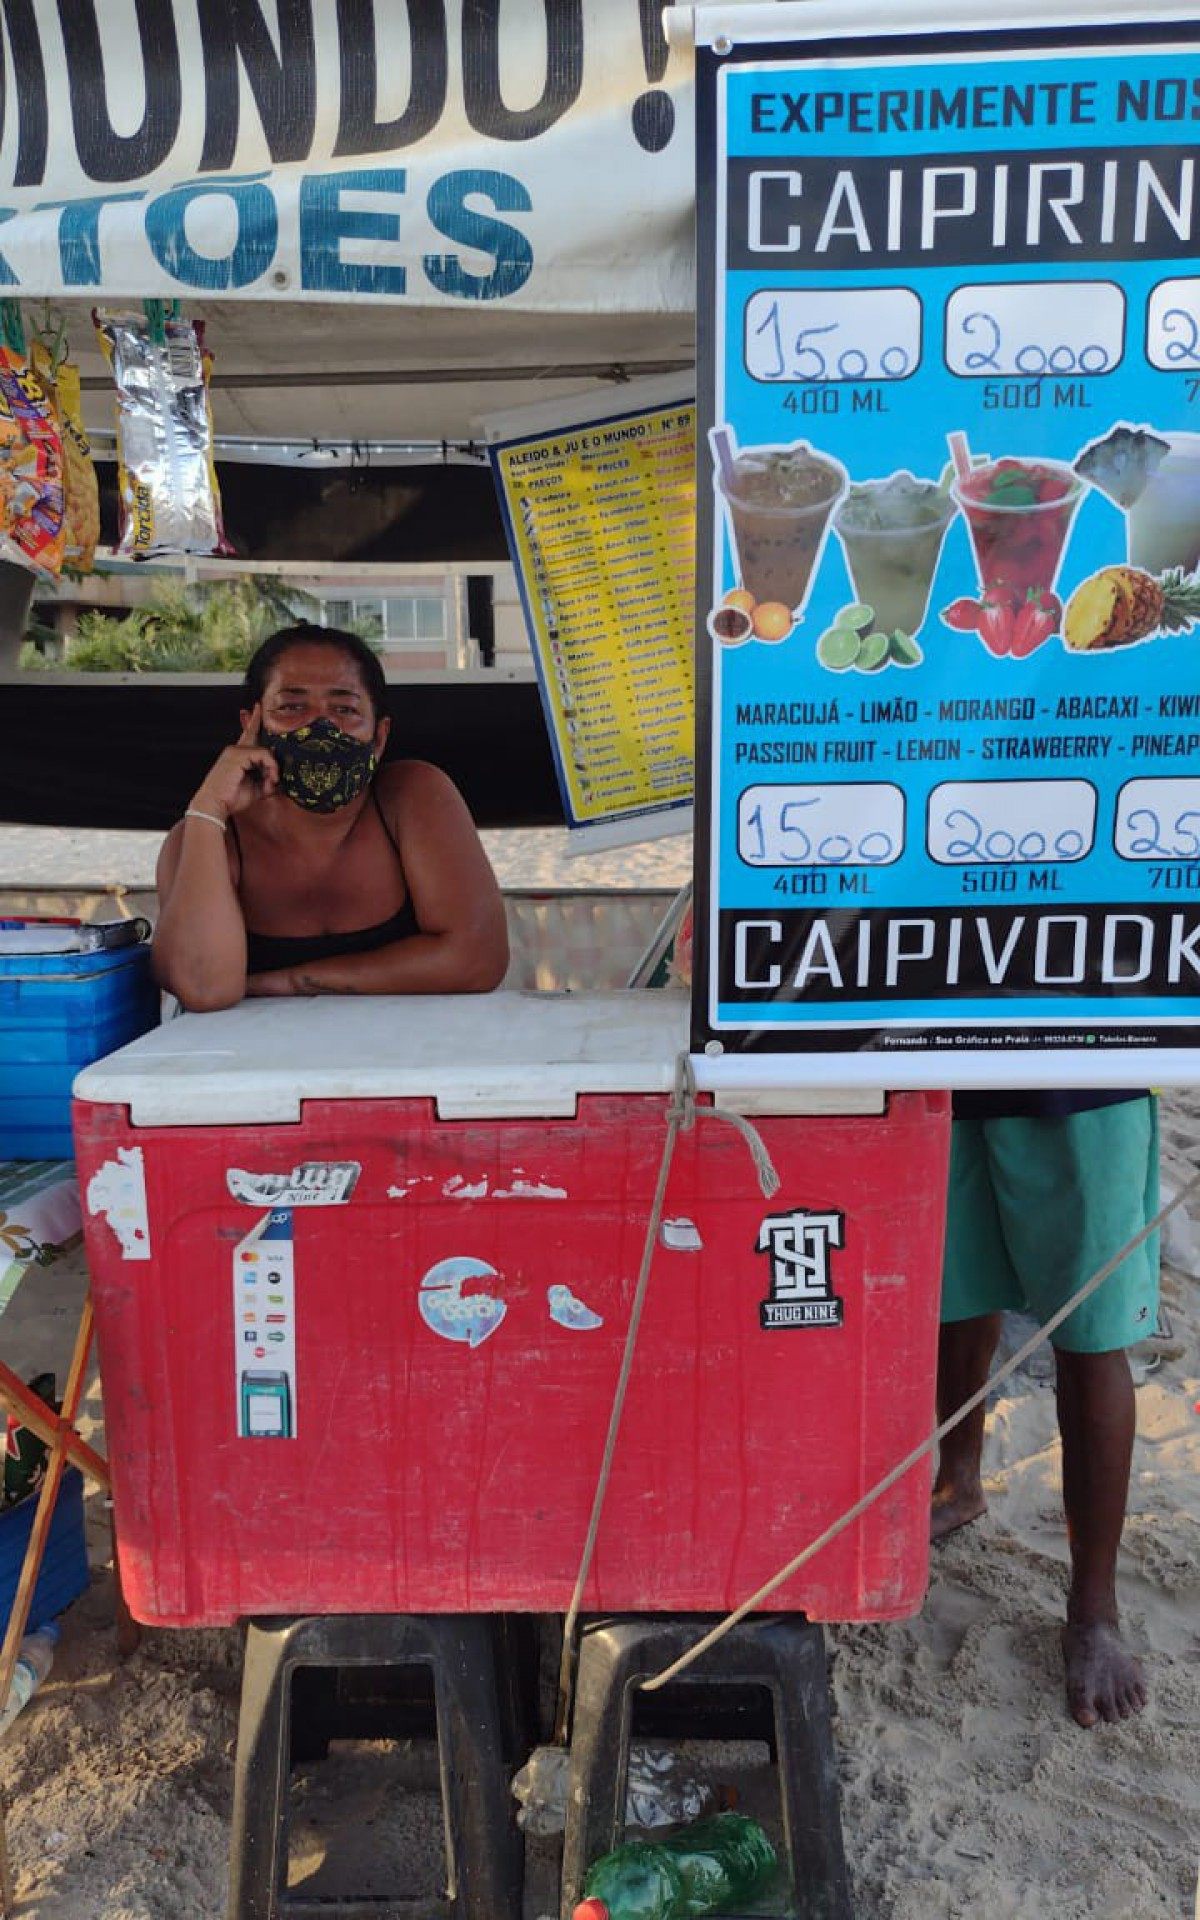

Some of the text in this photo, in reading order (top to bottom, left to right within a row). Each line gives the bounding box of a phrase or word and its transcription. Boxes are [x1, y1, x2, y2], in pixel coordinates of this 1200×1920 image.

[750, 81, 1098, 134] EXPERIMENTE
[748, 159, 1195, 252] CAIPIRIN
[782, 387, 889, 415] 400 ML
[983, 384, 1092, 410] 500 ML
[736, 699, 840, 725] MARACUJÁ
[860, 697, 918, 723] LIMÃO
[939, 698, 1036, 721] MORANGO
[1056, 696, 1139, 720] ABACAXI
[1159, 695, 1200, 718] KIWI
[736, 741, 817, 764] PASSION
[824, 740, 877, 763] FRUIT
[896, 739, 961, 761] LEMON
[982, 736, 1112, 760] STRAWBERRY
[1131, 734, 1200, 757] PINEAP
[773, 871, 876, 895] 400 ML
[962, 869, 1064, 892] 500 ML
[735, 914, 1200, 989] CAIPIVODK
[766, 1303, 838, 1321] THUG NINE
